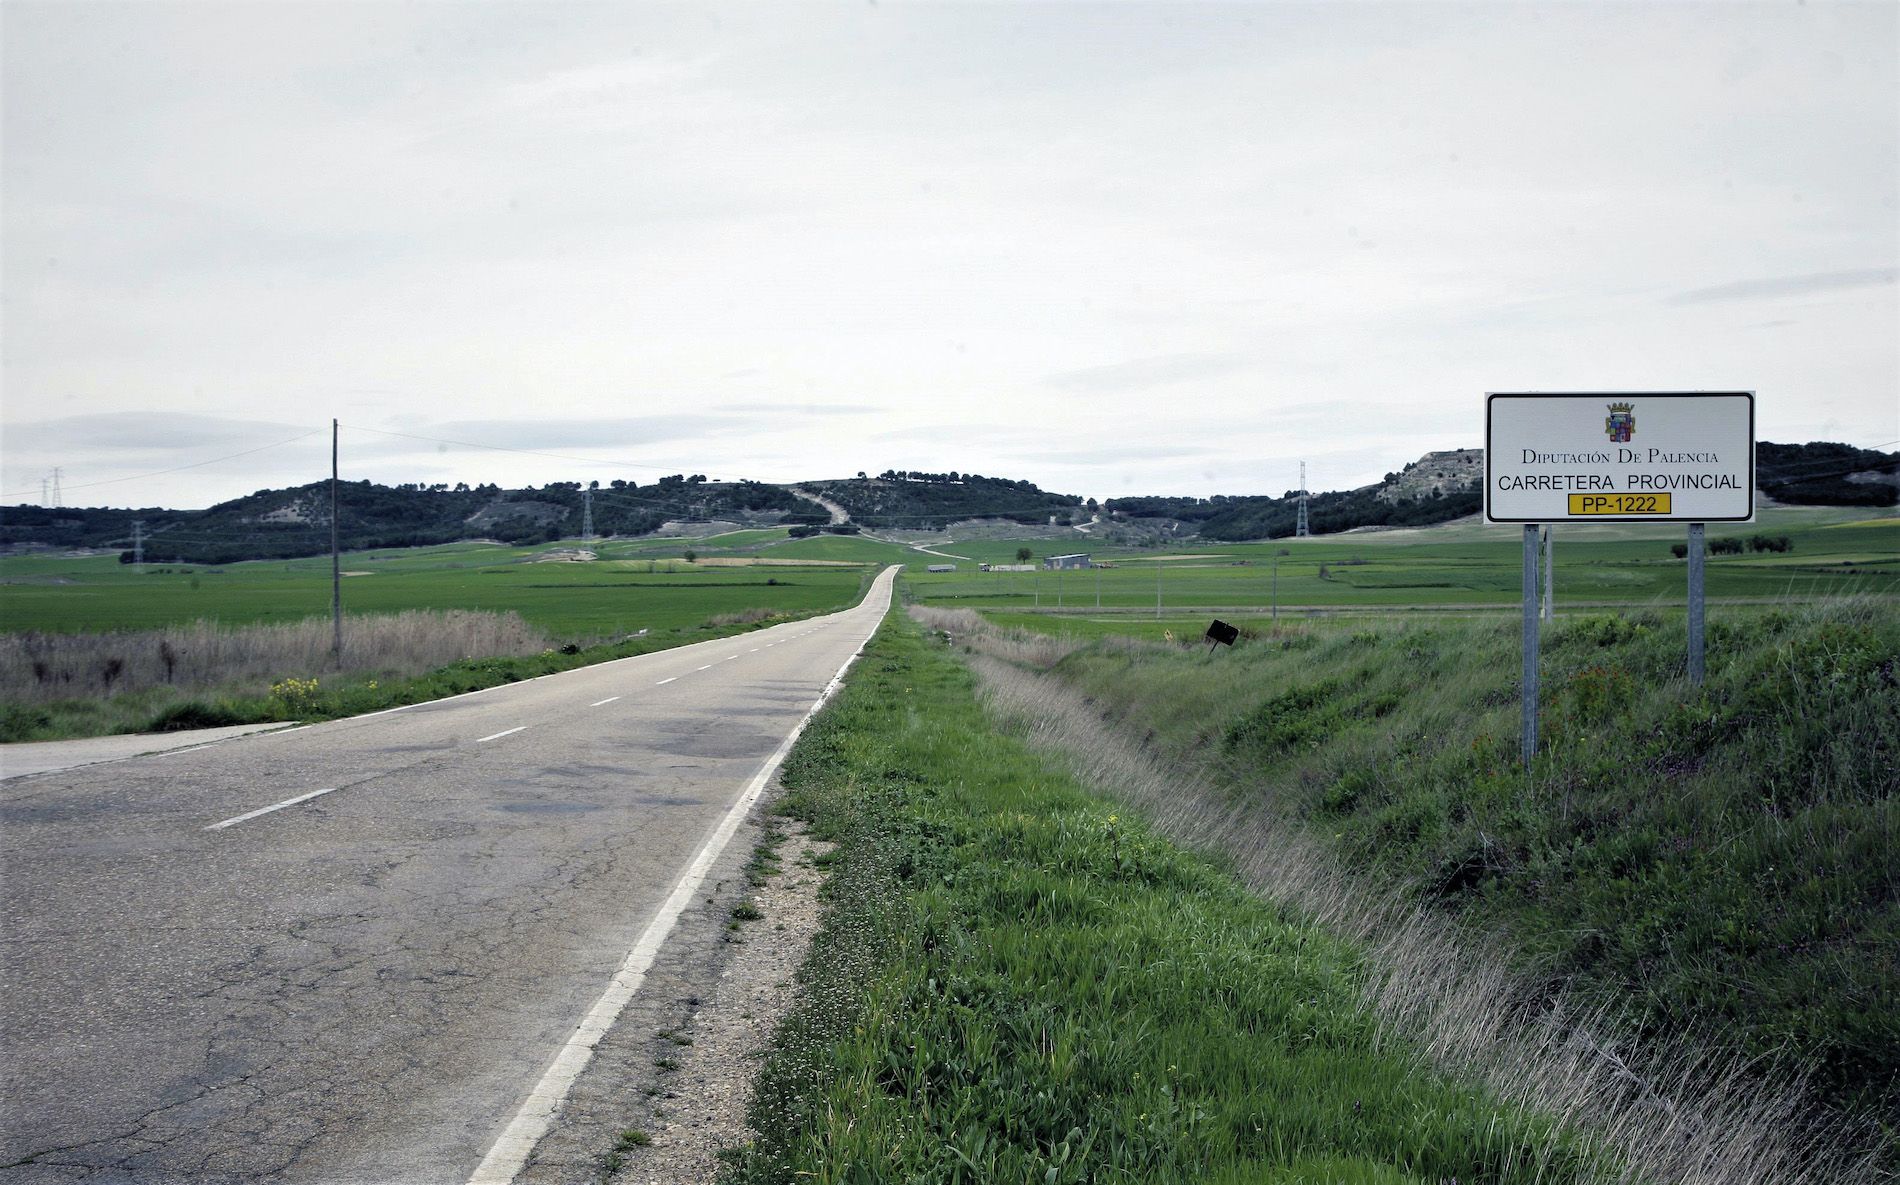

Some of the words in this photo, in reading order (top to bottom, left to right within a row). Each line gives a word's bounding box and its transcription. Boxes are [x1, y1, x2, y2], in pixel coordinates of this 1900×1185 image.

[1498, 475, 1614, 490] CARRETERA
[1627, 474, 1742, 489] PROVINCIAL
[1582, 496, 1657, 512] PP-1222
